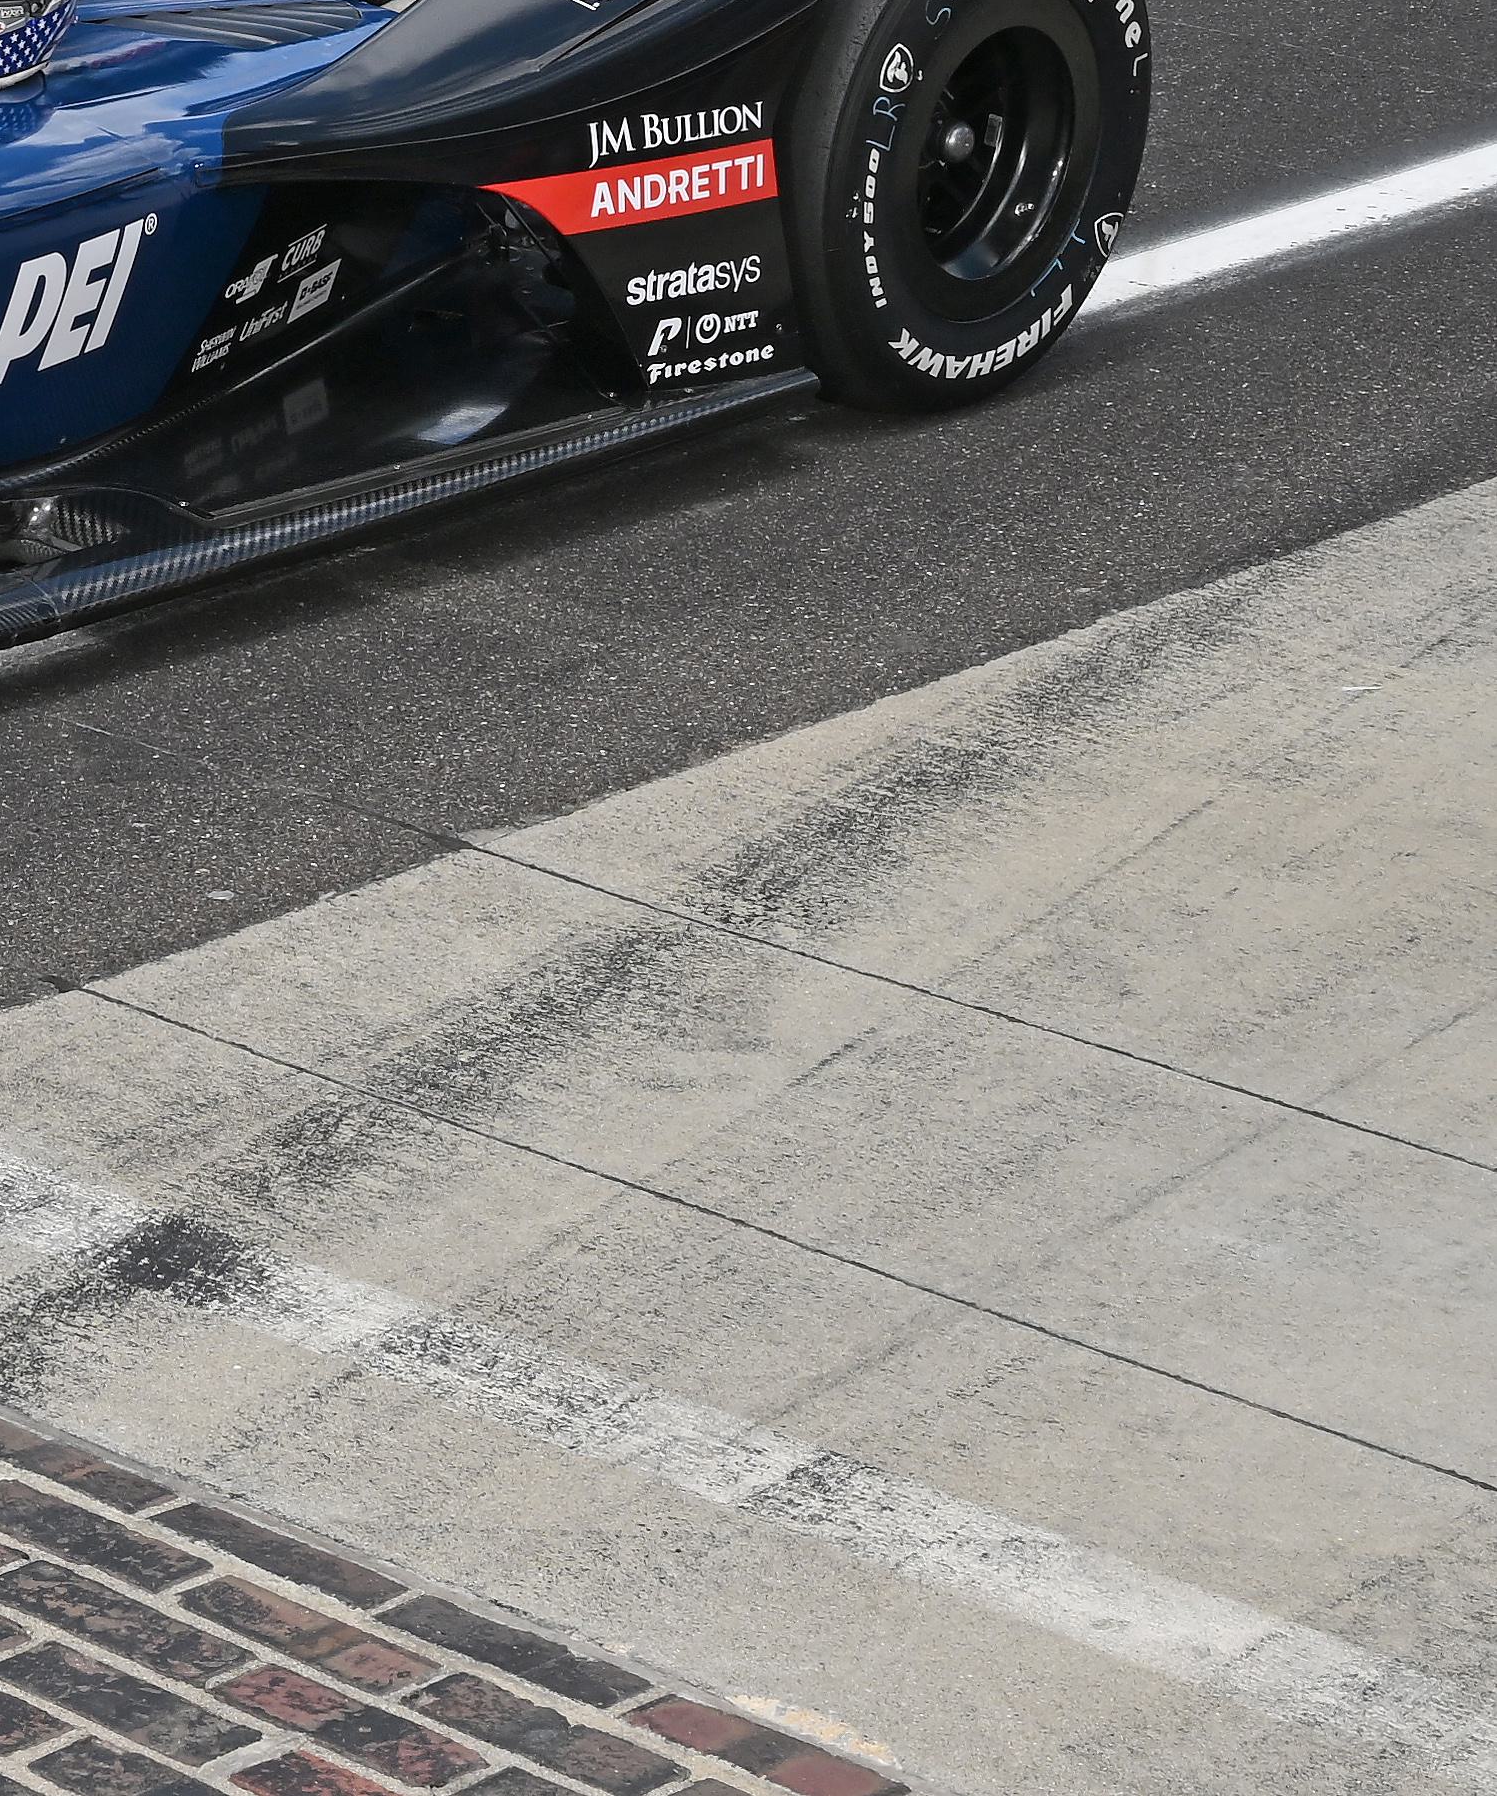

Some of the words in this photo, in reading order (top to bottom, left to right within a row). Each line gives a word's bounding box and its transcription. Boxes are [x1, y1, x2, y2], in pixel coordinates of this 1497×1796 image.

[587, 117, 636, 168] JM
[866, 96, 906, 152] LR
[590, 154, 764, 218] ANDRETTI
[281, 229, 326, 272] CURB
[626, 254, 761, 306] stratasys
[723, 310, 759, 335] NTT
[888, 284, 1073, 379] FIREHAWK
[647, 343, 775, 385] Firestone
